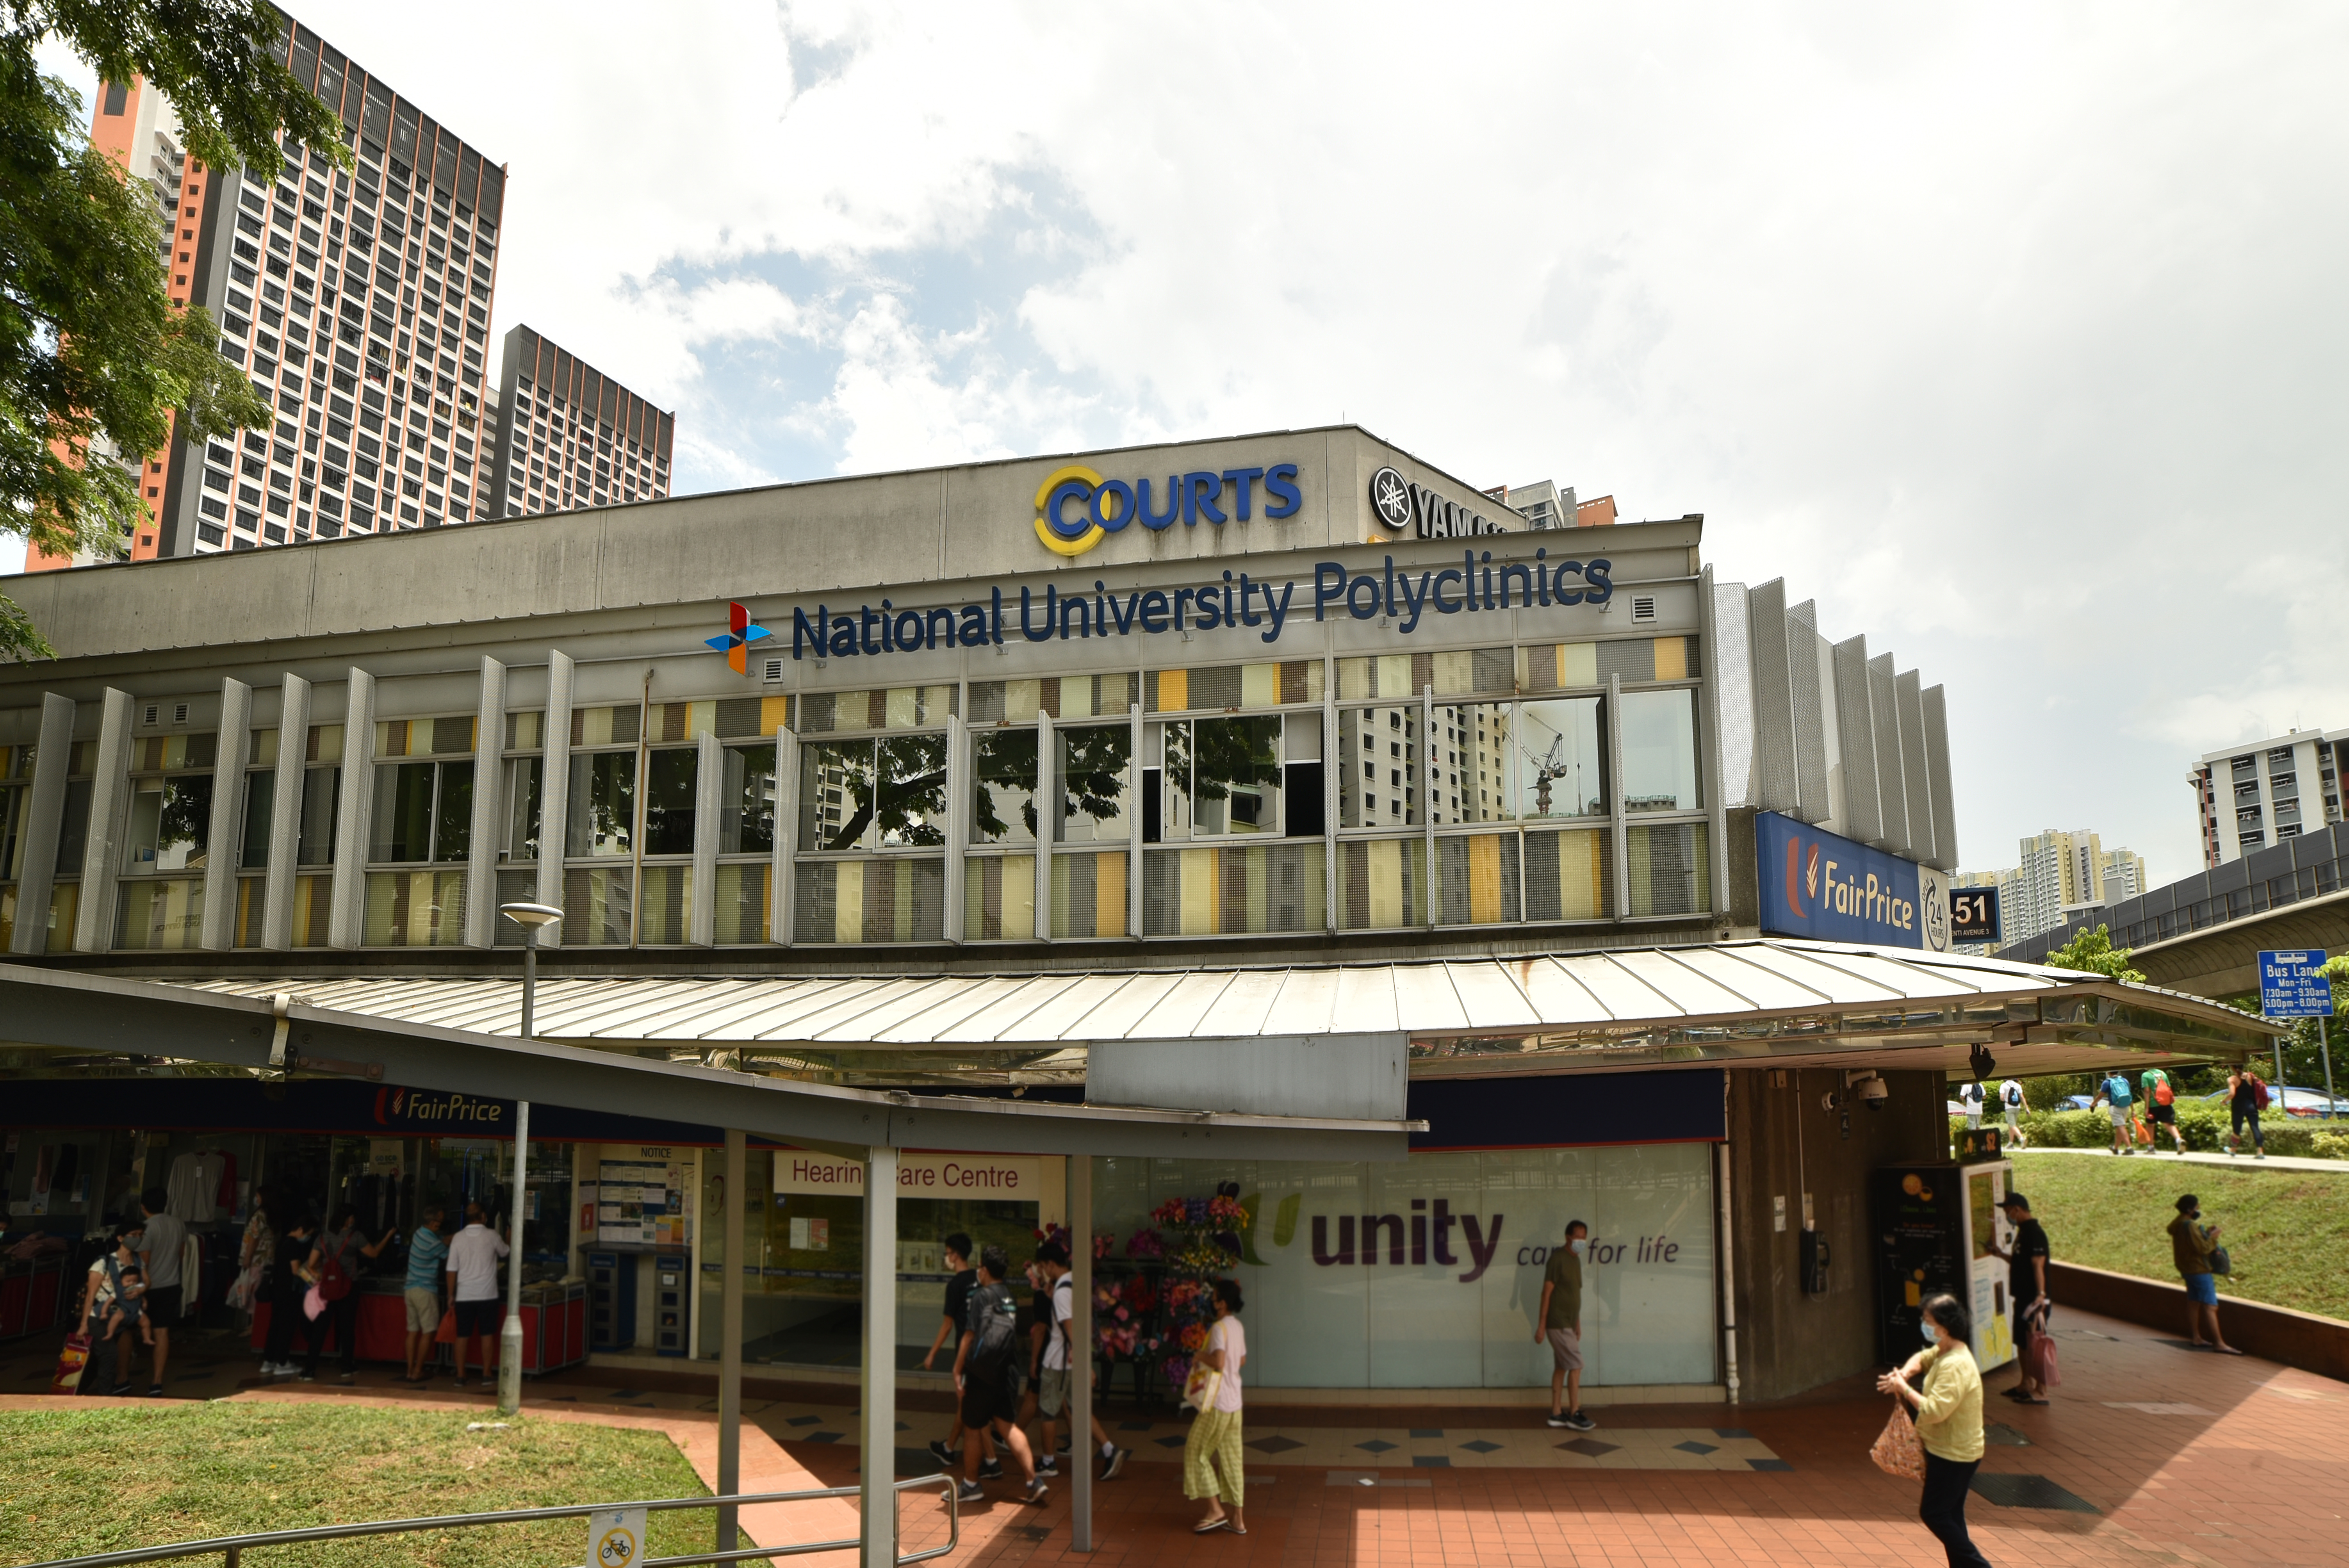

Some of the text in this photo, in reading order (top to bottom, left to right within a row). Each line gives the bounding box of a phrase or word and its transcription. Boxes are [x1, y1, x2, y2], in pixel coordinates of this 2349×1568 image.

[1048, 463, 1302, 537] COURTS
[1410, 483, 1507, 539] YAMA
[793, 547, 1613, 660] National University Polyclinics
[1825, 861, 1912, 930] FairPrice
[1921, 877, 1930, 902] OPEN
[1930, 901, 1943, 927] 24
[1951, 895, 1987, 924] 51
[1931, 927, 1944, 939] HOURS
[2267, 965, 2288, 977] Bus
[407, 1094, 502, 1122] FairPrice
[641, 1147, 671, 1158] NOTICE
[793, 1159, 1018, 1188] Hearin are Centre
[1312, 1199, 1504, 1283] unity
[1588, 1238, 1628, 1265] for
[1637, 1235, 1679, 1265] life
